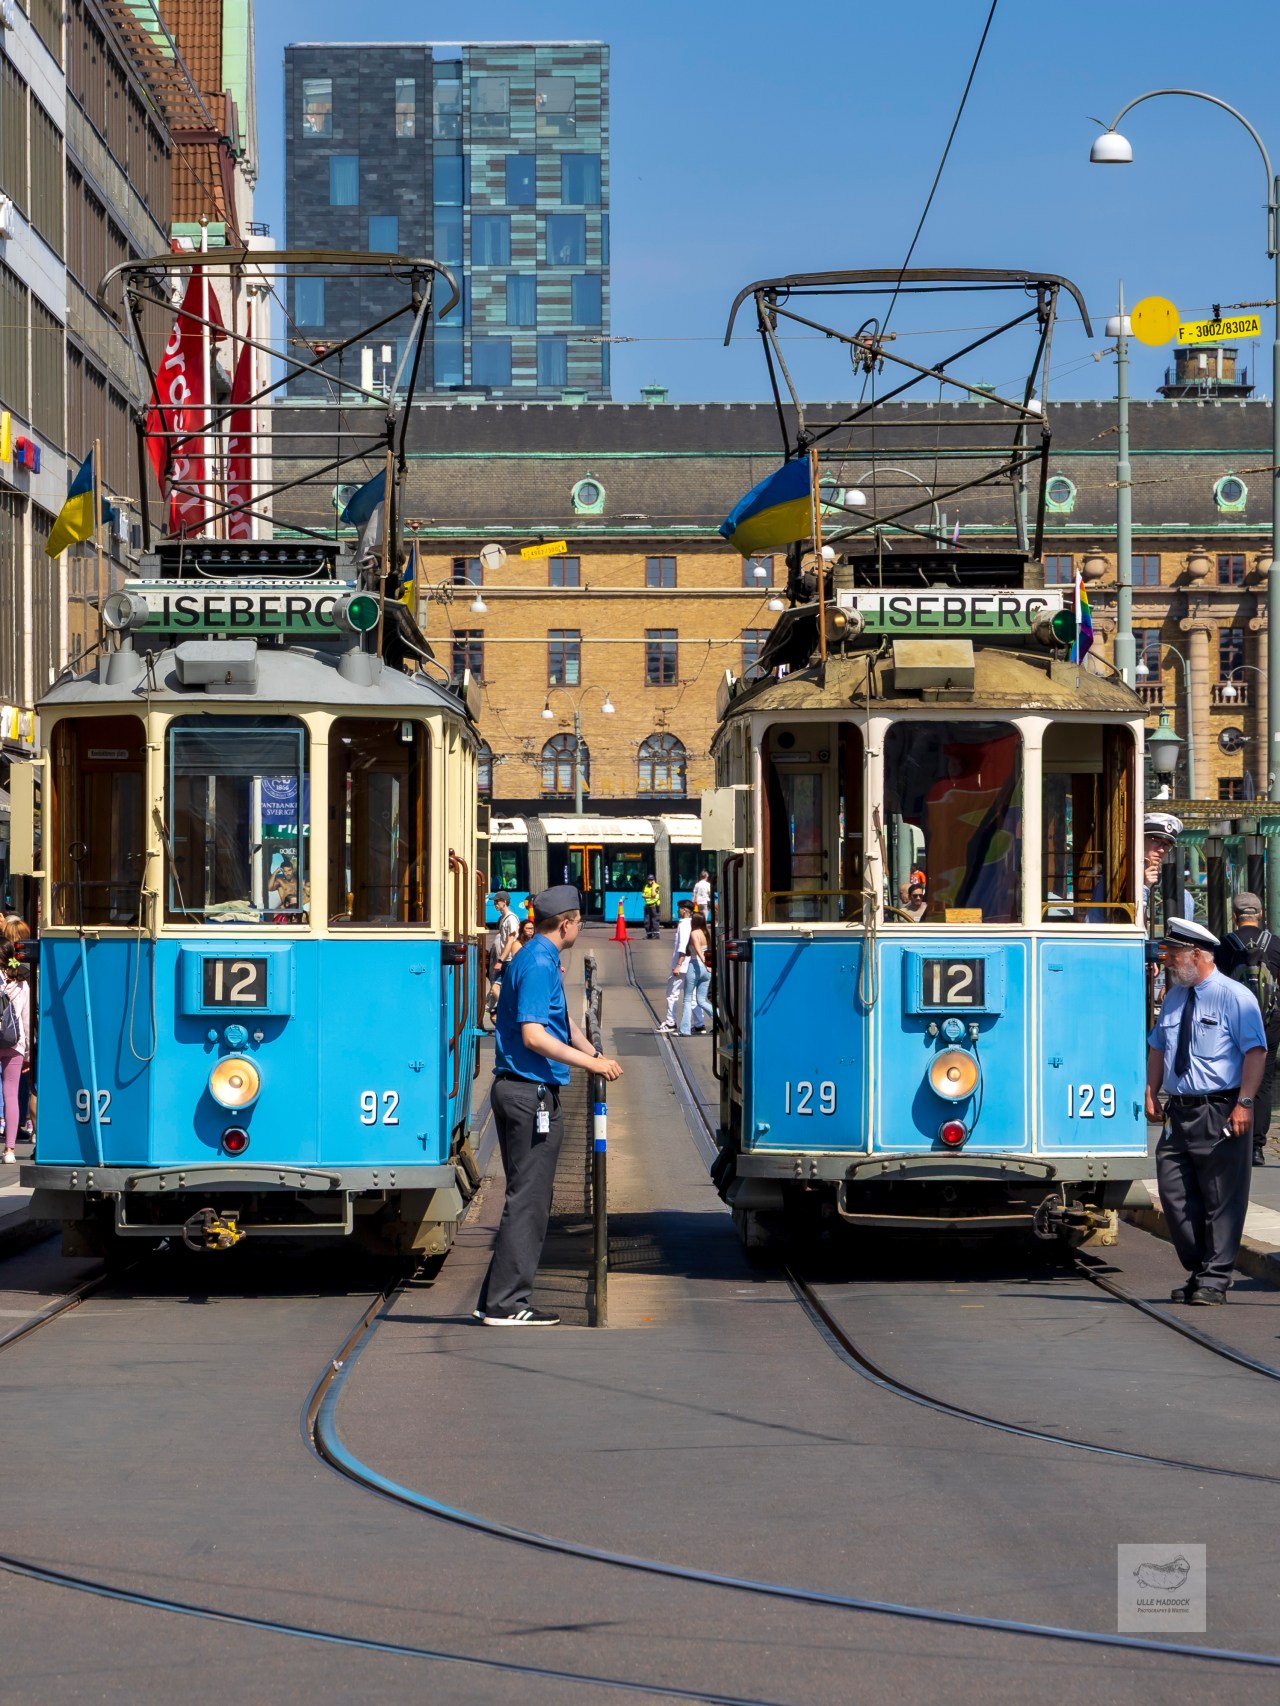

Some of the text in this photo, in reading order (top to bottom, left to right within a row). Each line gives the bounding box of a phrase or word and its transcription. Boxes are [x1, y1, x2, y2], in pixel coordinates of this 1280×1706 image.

[1178, 327, 1185, 340] F
[1196, 319, 1258, 338] 3002/8302A
[215, 961, 258, 1002] 12
[932, 963, 974, 1004] 12
[75, 1089, 112, 1124] 92
[360, 1090, 400, 1126] 92
[784, 1080, 837, 1116] 129
[1067, 1083, 1117, 1119] 129
